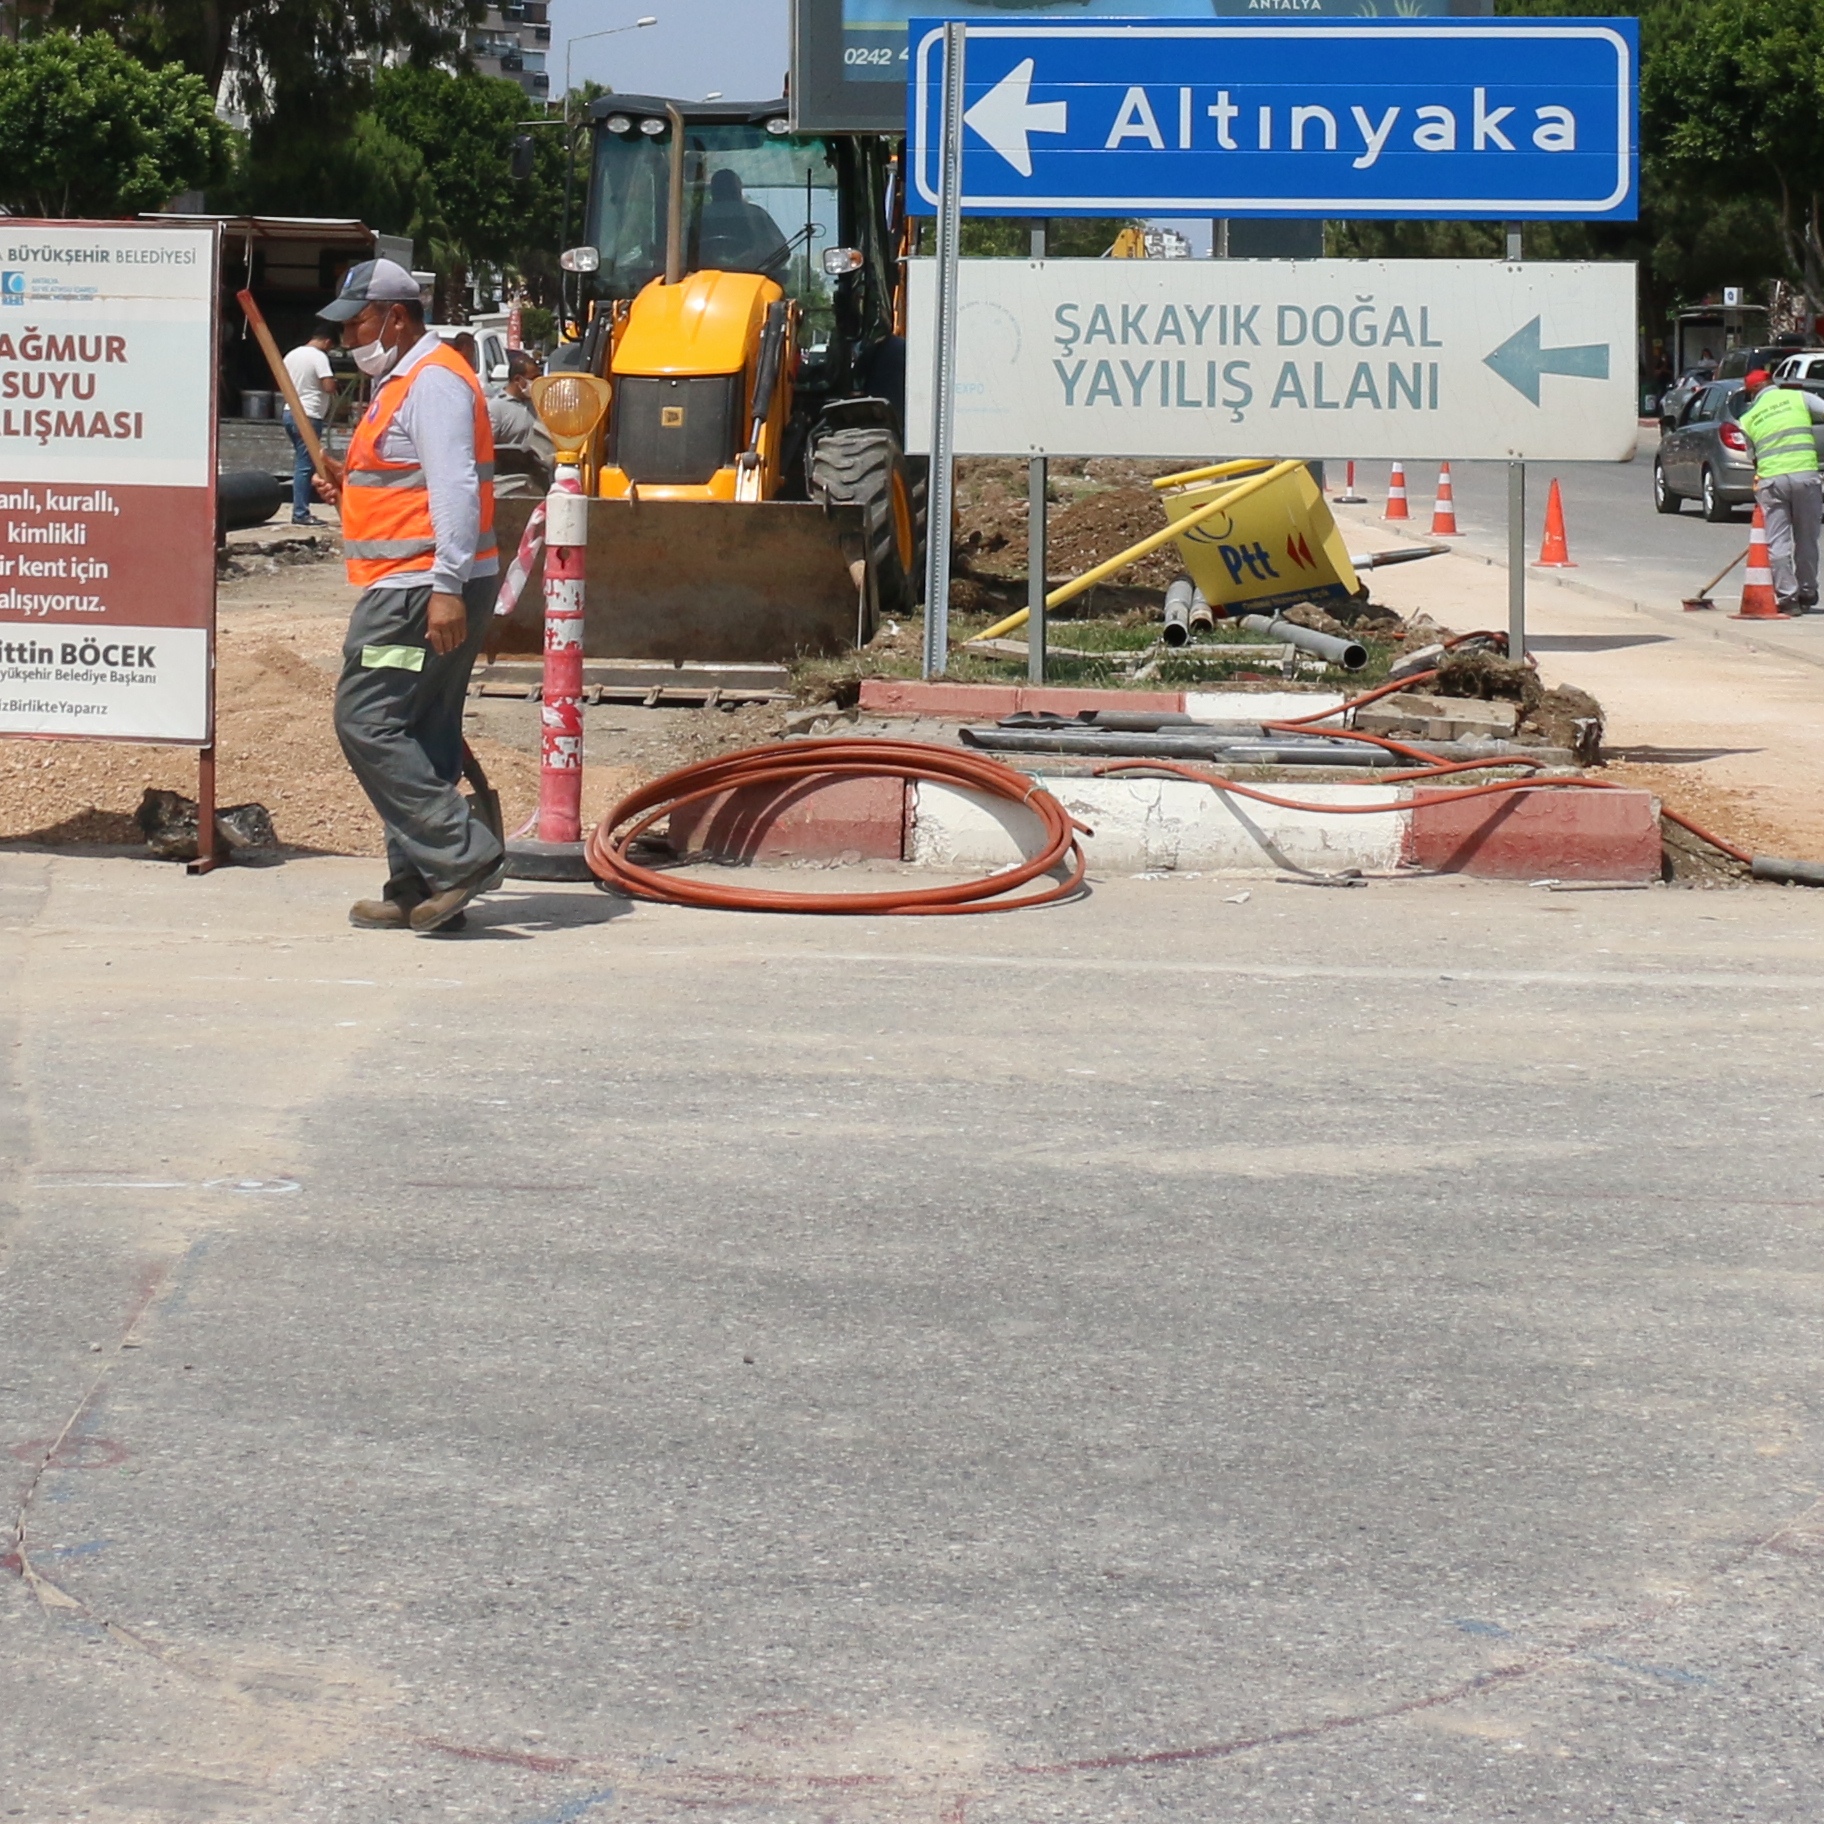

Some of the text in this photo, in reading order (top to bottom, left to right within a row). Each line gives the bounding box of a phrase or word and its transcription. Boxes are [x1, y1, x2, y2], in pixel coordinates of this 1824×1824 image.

[844, 47, 893, 65] 0242
[1104, 86, 1576, 169] Altınyaka
[7, 244, 110, 266] BÜYÜKŞEHİR
[115, 247, 197, 265] BELEDİYESİ
[1053, 302, 1261, 357] ŞAKAYIK
[1277, 294, 1443, 347] DOĞAL
[1, 370, 96, 400] SUYU
[1052, 359, 1439, 424] YAYILIŞ ALANI
[45, 488, 120, 516] kurallı,
[7, 520, 86, 545] kimlikli
[18, 554, 67, 577] kent
[70, 556, 109, 584] için
[1217, 541, 1280, 585] Ptt
[60, 636, 157, 668] BÖCEK
[55, 669, 107, 685] Belediye
[110, 671, 157, 687] Başkanı
